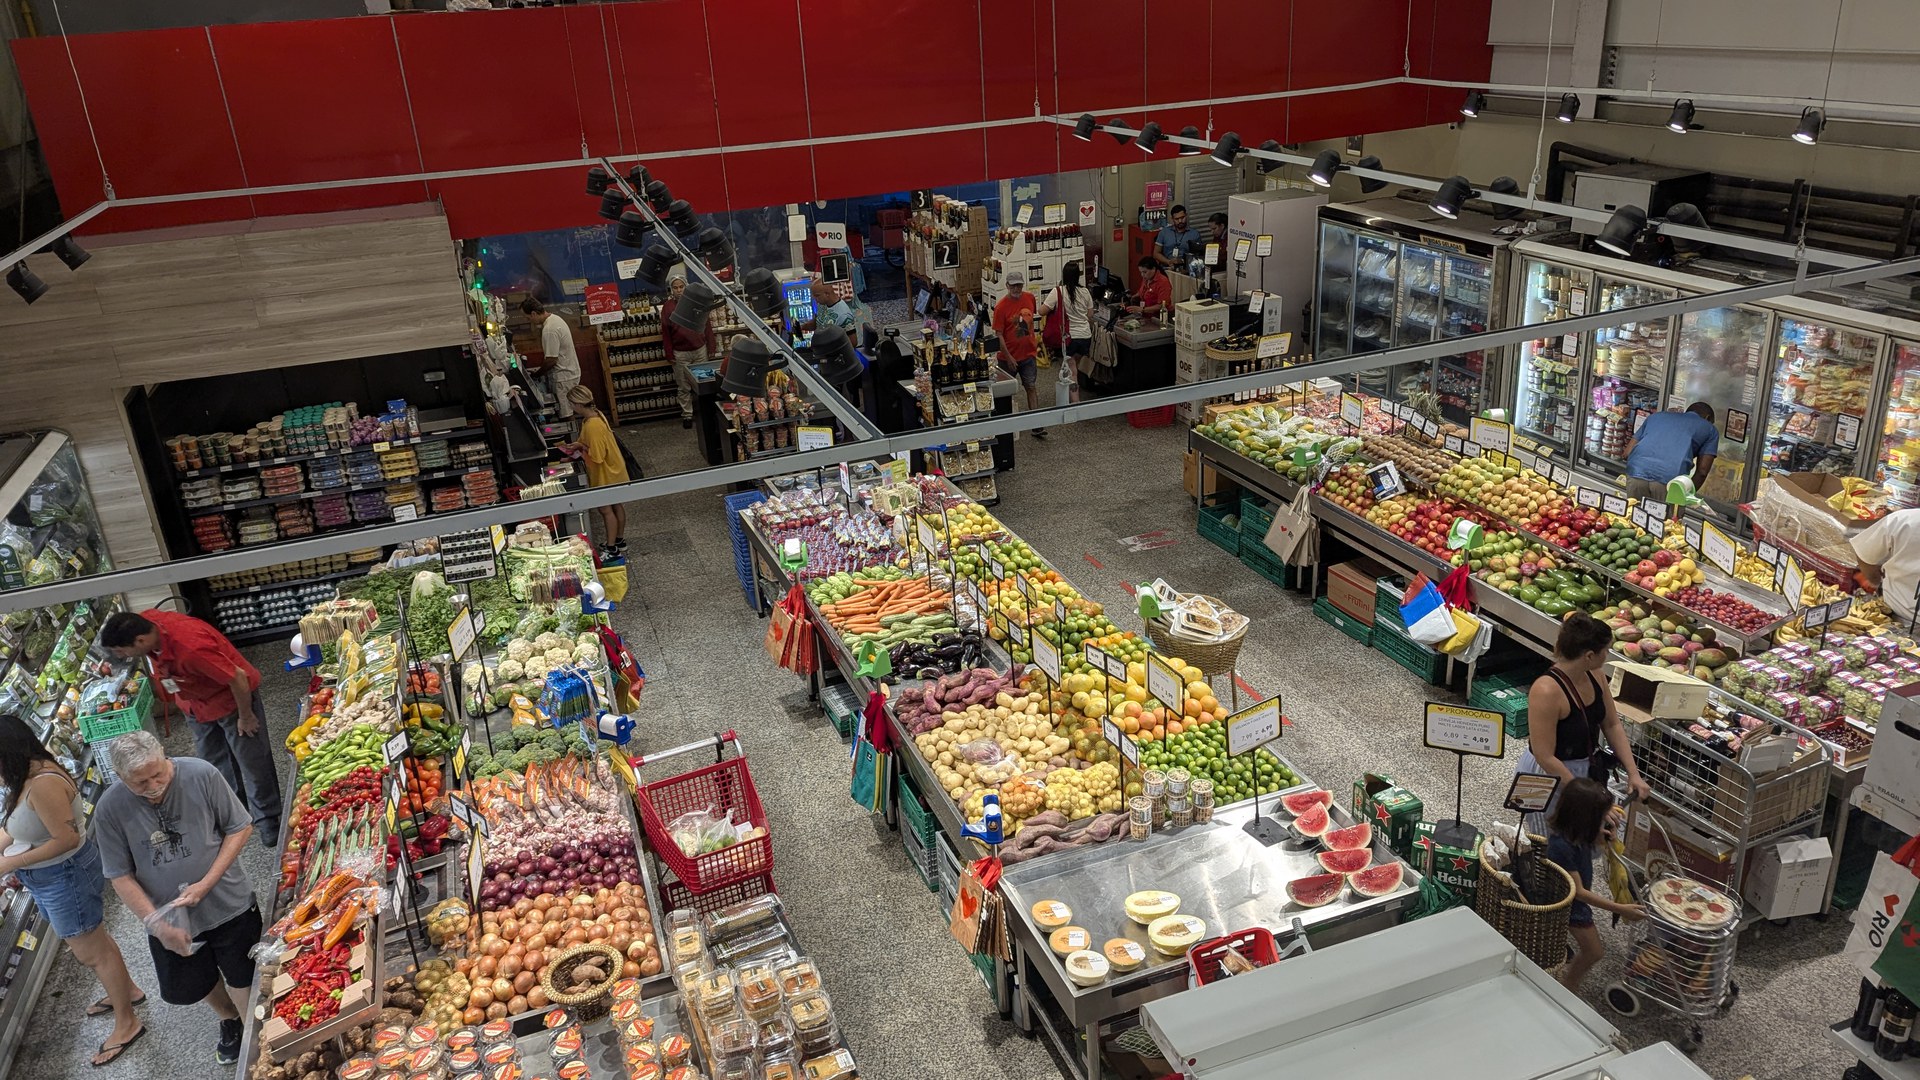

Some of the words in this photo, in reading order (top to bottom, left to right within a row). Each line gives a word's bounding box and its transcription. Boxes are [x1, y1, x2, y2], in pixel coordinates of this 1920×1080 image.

[917, 191, 925, 208] 3
[828, 232, 842, 240] RIO
[942, 245, 950, 265] 2
[832, 259, 838, 279] 1
[1200, 321, 1223, 334] ODE
[1179, 360, 1192, 374] ODE
[1347, 594, 1370, 612] Frutini
[1241, 701, 1272, 718] PROMOÇÃO
[1446, 707, 1491, 720] PROMOÇÃO
[1472, 736, 1489, 744] 4,89
[1877, 786, 1906, 804] FRAGILE
[328, 872, 350, 898] Palermo
[1868, 910, 1890, 948] RIO
